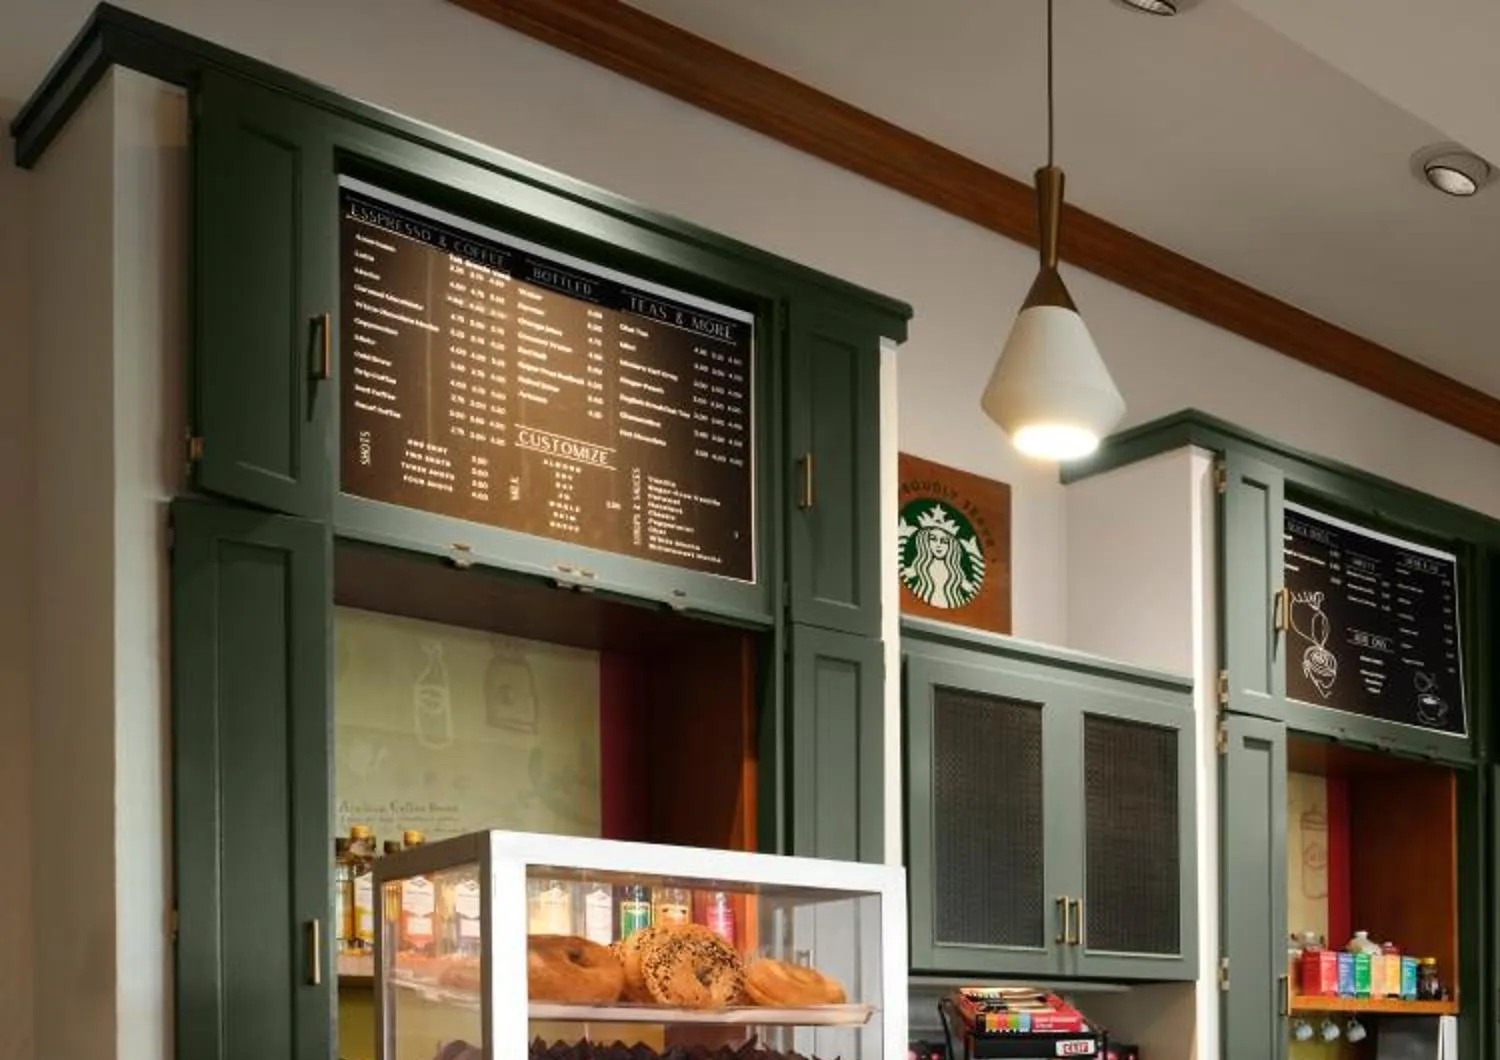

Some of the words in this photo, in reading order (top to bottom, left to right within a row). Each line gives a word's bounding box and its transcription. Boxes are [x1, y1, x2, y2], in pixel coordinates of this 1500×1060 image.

[454, 238, 504, 267] COFFEE
[533, 267, 591, 295] BOTTLED
[631, 296, 666, 319] TEAS
[692, 315, 728, 338] MORE
[359, 429, 370, 466] SHOTS
[518, 429, 608, 464] CUSTOMIZE
[1063, 1041, 1089, 1054] CLIF
